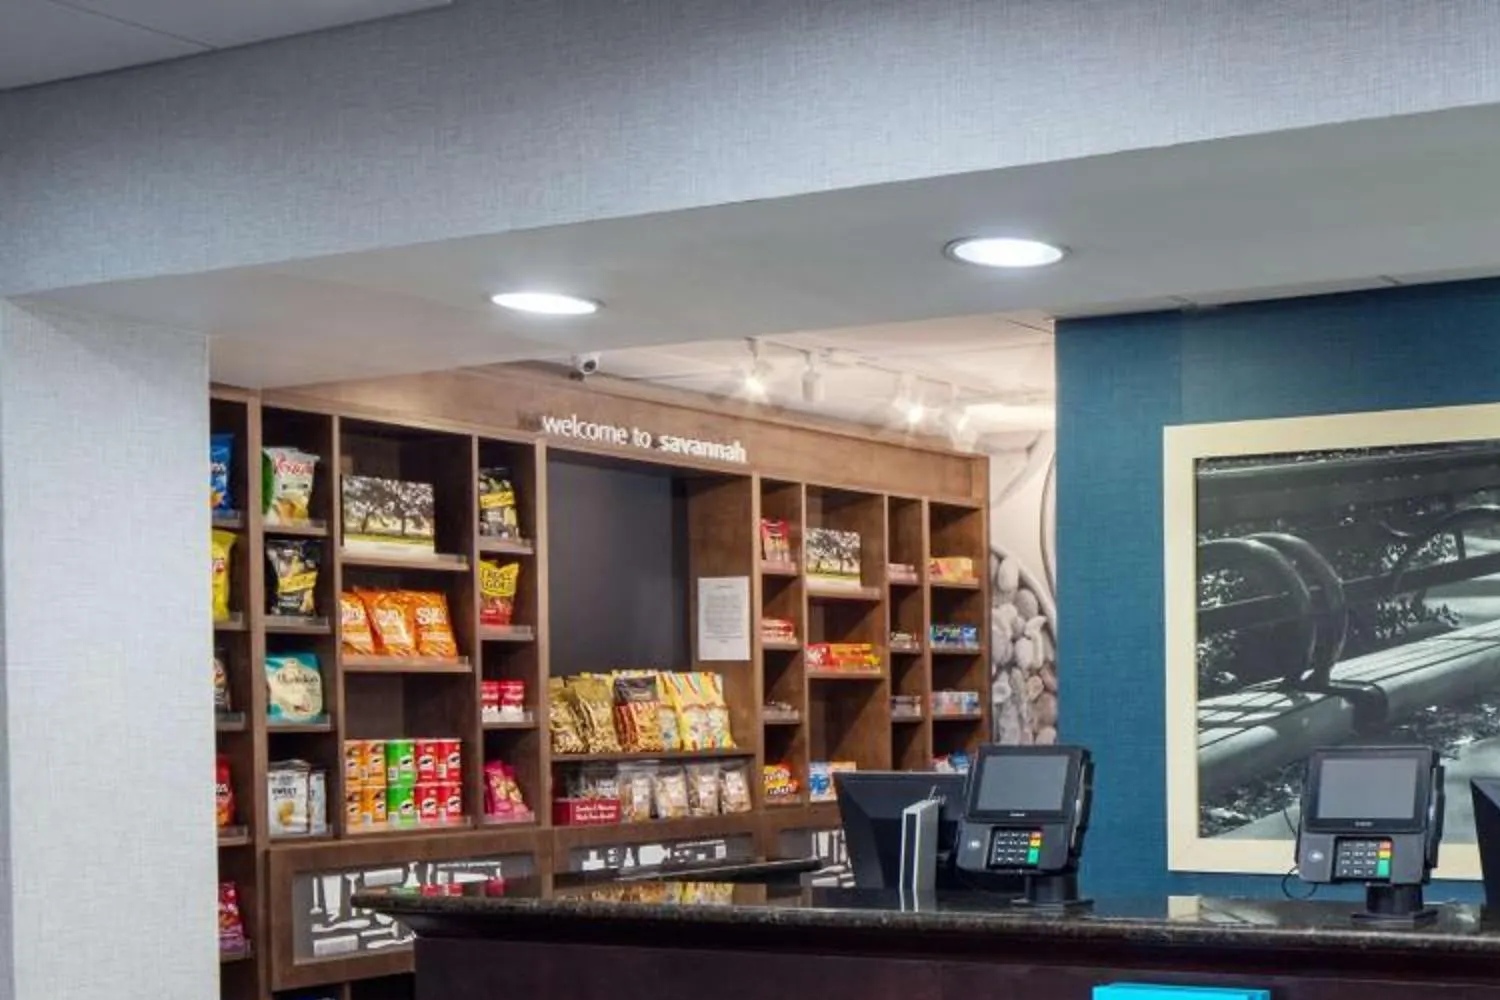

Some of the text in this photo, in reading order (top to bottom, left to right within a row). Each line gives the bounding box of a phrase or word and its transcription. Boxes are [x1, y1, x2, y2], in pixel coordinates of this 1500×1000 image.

[542, 413, 747, 464] welcome to savannah
